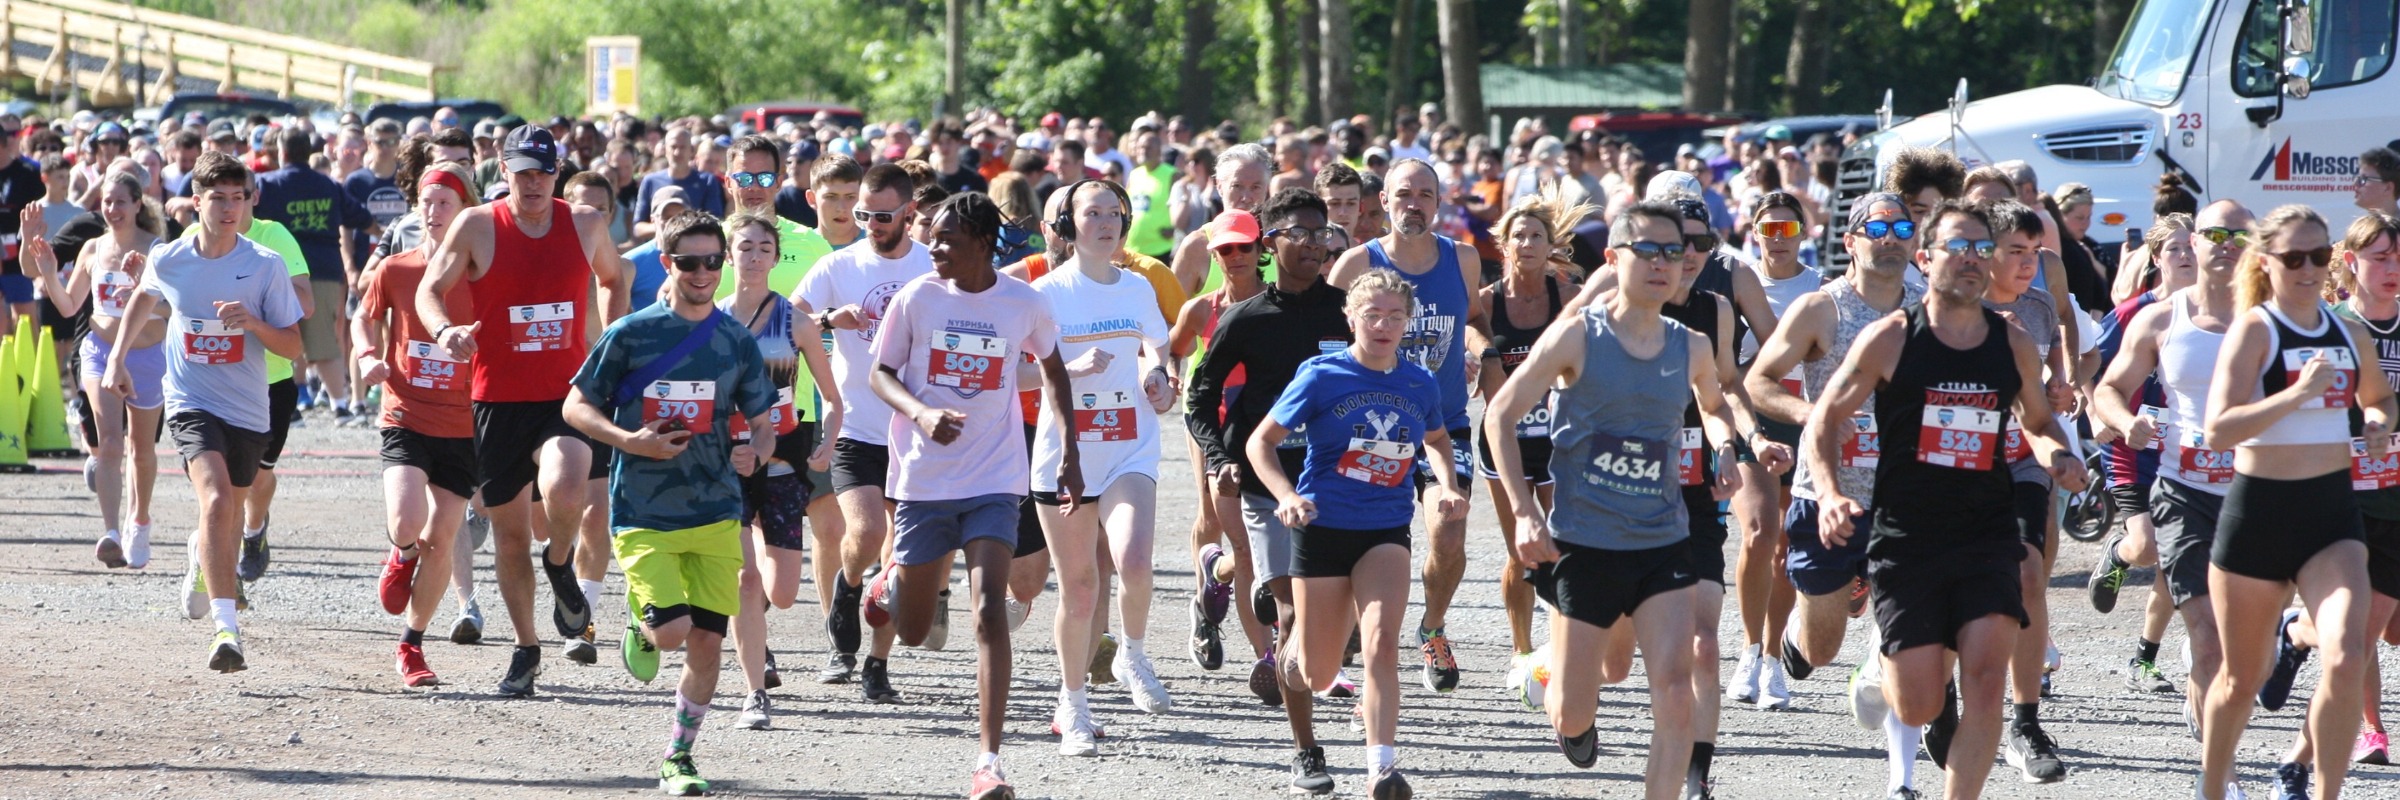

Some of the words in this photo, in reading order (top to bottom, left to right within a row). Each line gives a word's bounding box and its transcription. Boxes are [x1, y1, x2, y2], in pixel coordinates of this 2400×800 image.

[2176, 113, 2202, 129] 23
[2292, 152, 2359, 175] Messc
[286, 198, 332, 215] CREW
[525, 321, 563, 338] 433
[947, 319, 995, 330] NYSPHSAA
[192, 336, 232, 351] 406
[418, 360, 455, 377] 354
[944, 353, 990, 374] 509
[1947, 382, 1978, 391] TEAM
[656, 400, 699, 418] 370
[1925, 390, 1998, 410] PICCOLO
[1092, 410, 1119, 427] 43
[1938, 430, 1982, 452] 526
[1355, 453, 1401, 475] 420
[1593, 452, 1662, 482] 4634
[2194, 450, 2234, 469] 628
[2359, 454, 2399, 475] 564
